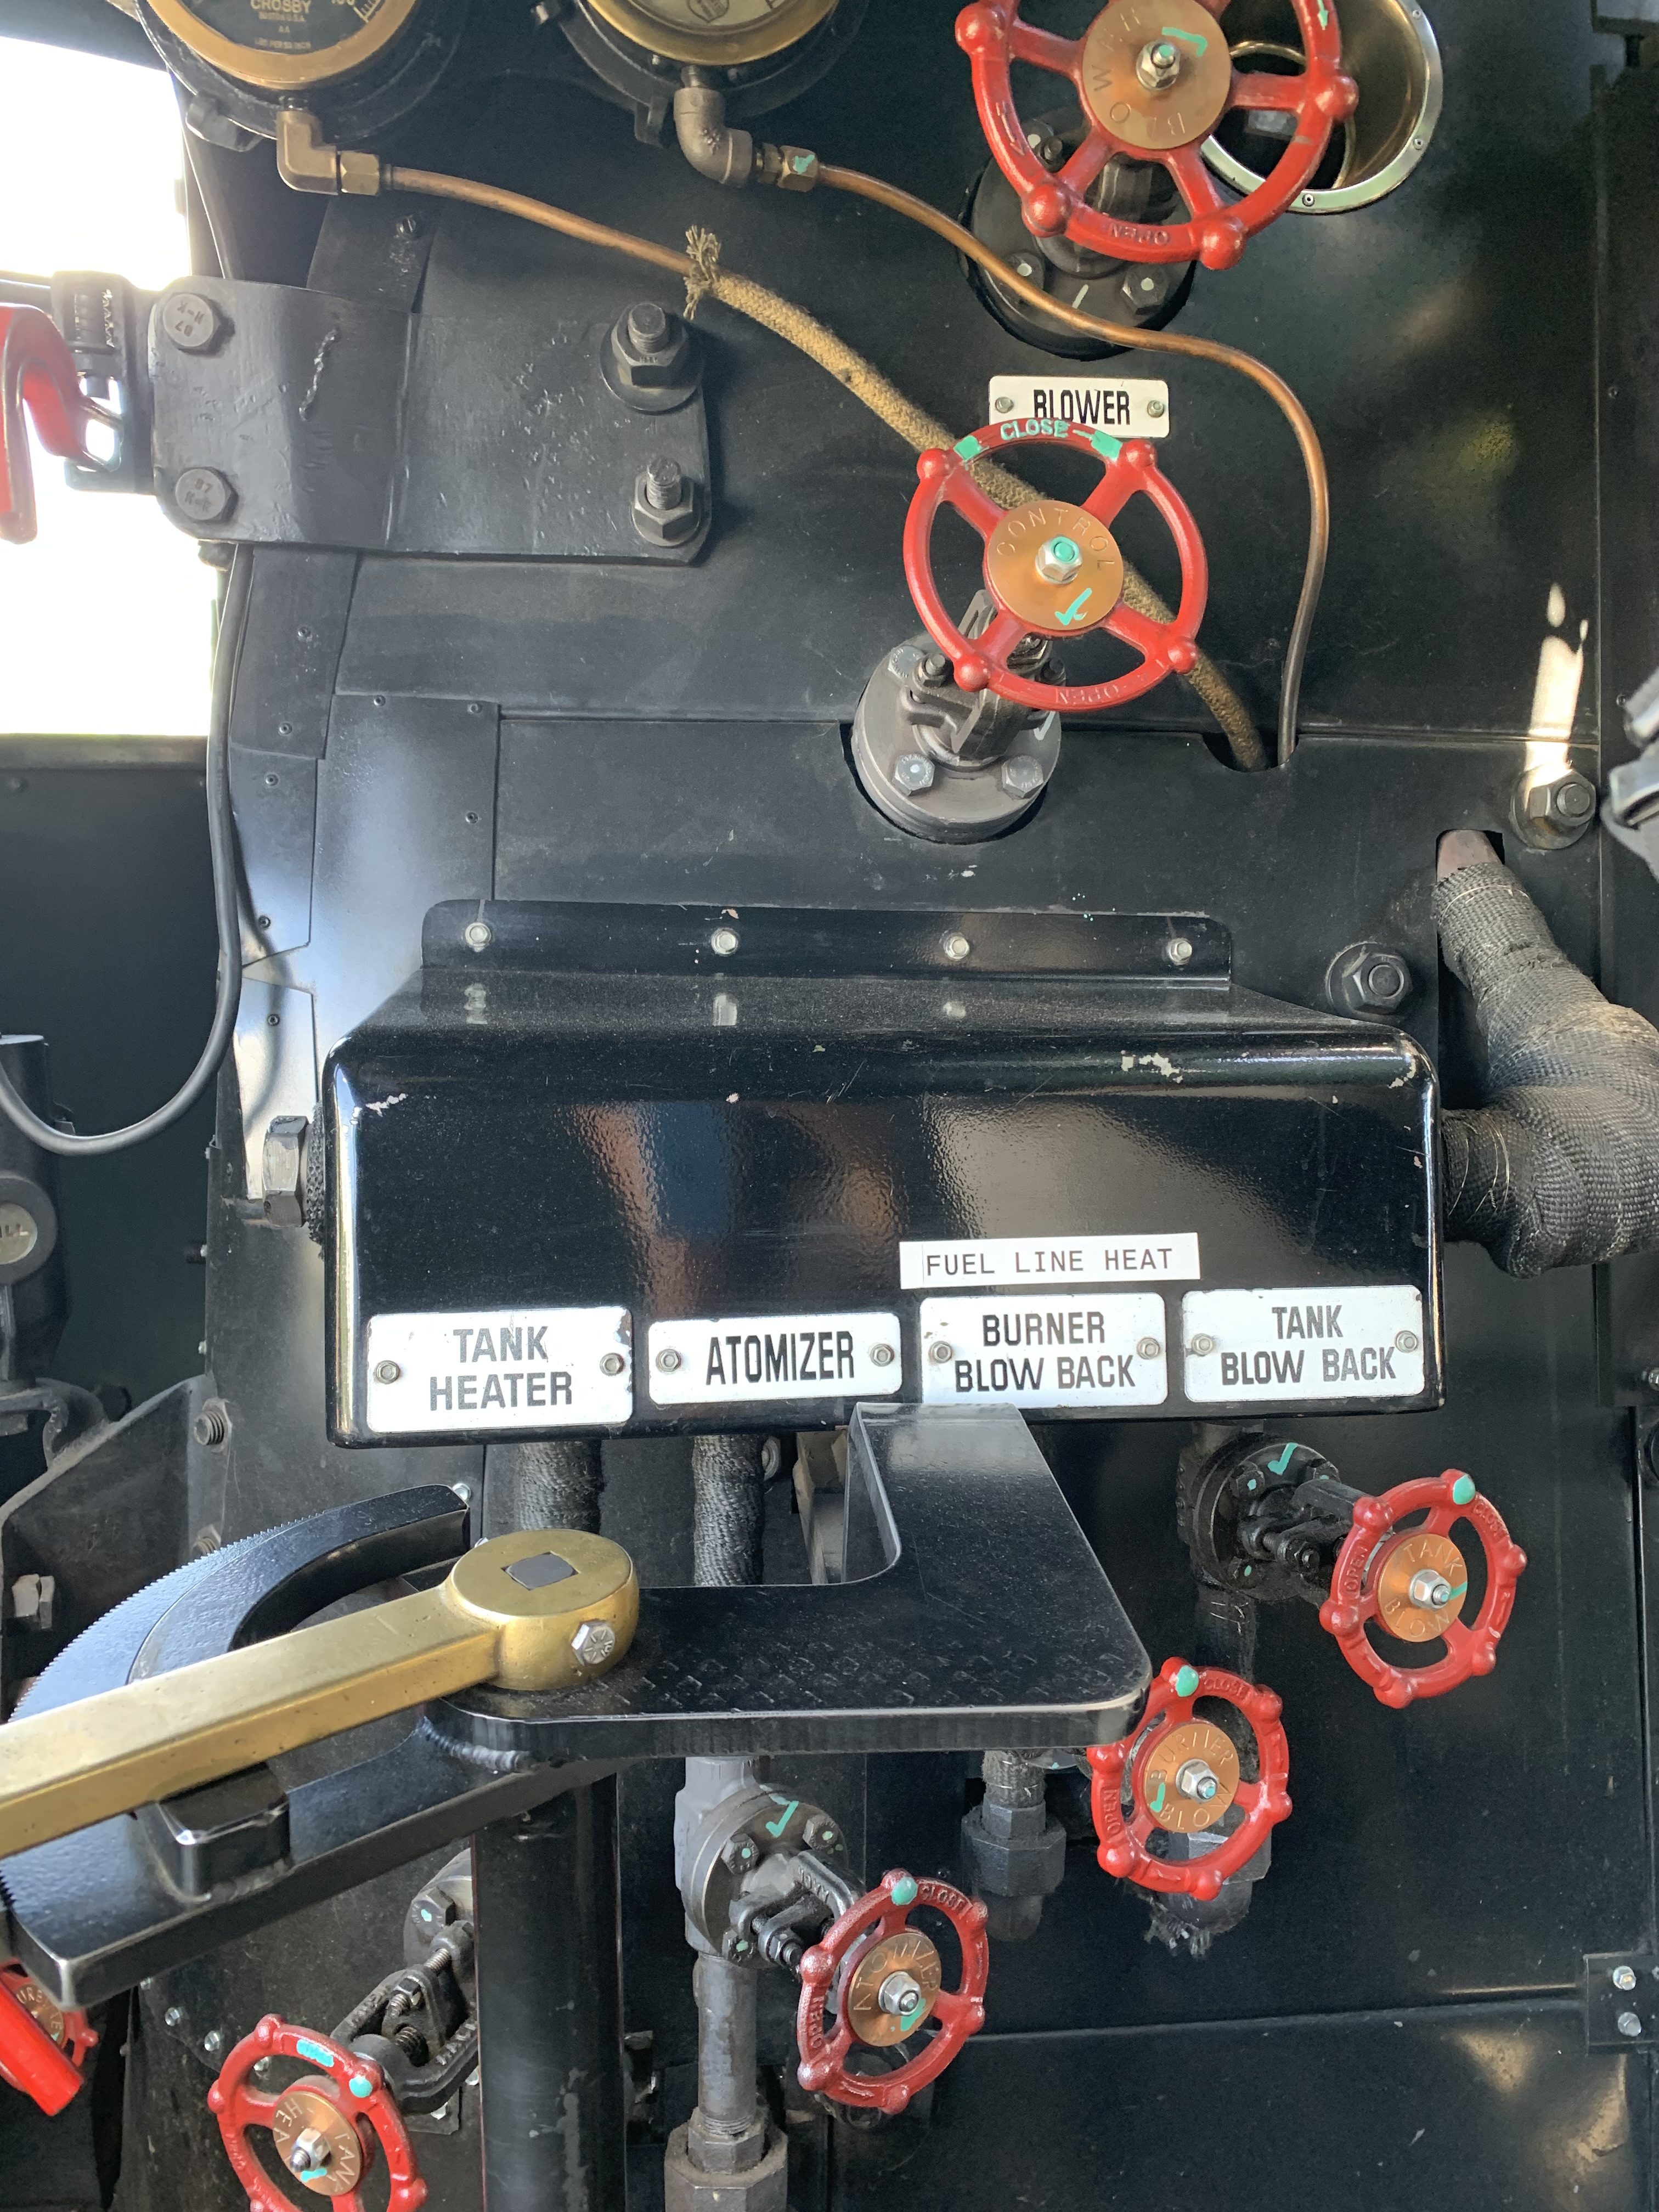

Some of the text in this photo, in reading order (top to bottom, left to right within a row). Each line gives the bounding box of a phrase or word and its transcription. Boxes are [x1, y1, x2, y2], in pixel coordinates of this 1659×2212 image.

[250, 0, 311, 14] CROSBY
[1034, 389, 1131, 426] BLOWER
[1000, 418, 1070, 440] CLOSE
[996, 506, 1115, 570] CONTROL
[926, 1248, 1172, 1276] FUEL LINE HEAT
[982, 1311, 1105, 1346] BURNER
[1272, 1305, 1344, 1339] TANK
[453, 1326, 549, 1363] TANK
[706, 1331, 855, 1385] ATOMIZER
[955, 1355, 1136, 1392] BLOW BACK
[1221, 1347, 1396, 1385] BLOW BACK
[430, 1372, 572, 1410] HEATER
[1403, 1539, 1464, 1577] TANK
[1385, 1597, 1451, 1638] BLOW
[1204, 1678, 1249, 1697] CLOSE
[1103, 1788, 1121, 1838] OPEN
[1158, 1782, 1233, 1831] BLOW
[921, 1884, 964, 1911] CLOSE
[326, 2132, 356, 2193] TANK
